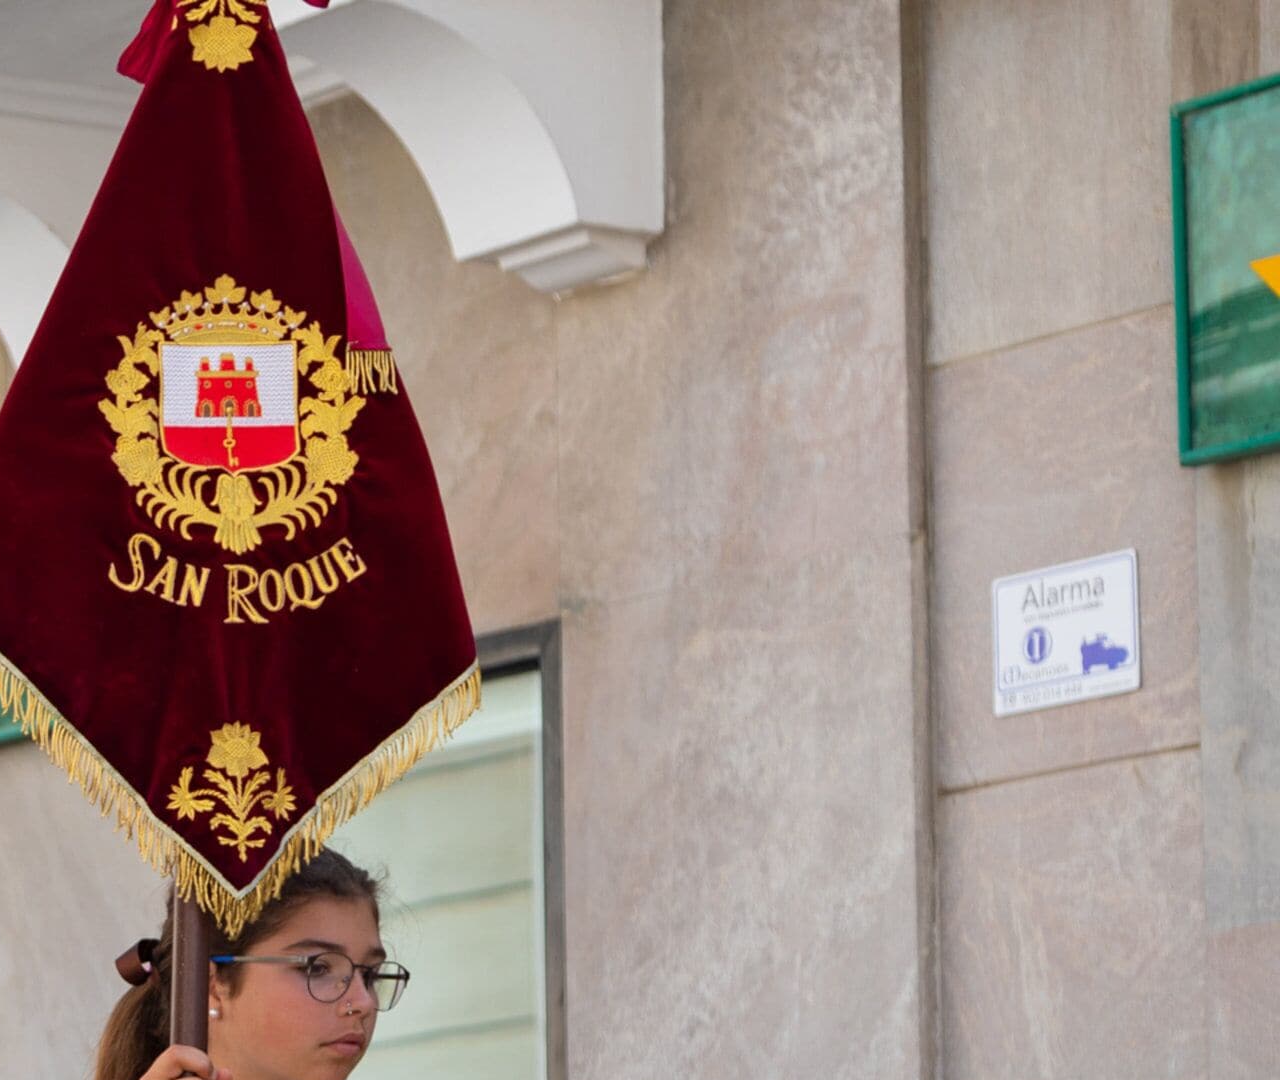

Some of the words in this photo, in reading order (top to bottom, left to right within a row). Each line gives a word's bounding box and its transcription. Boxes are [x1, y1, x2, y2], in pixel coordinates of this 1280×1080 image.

[108, 533, 211, 607] SAN
[223, 537, 367, 624] ROQUE
[1022, 576, 1105, 612] Alarma
